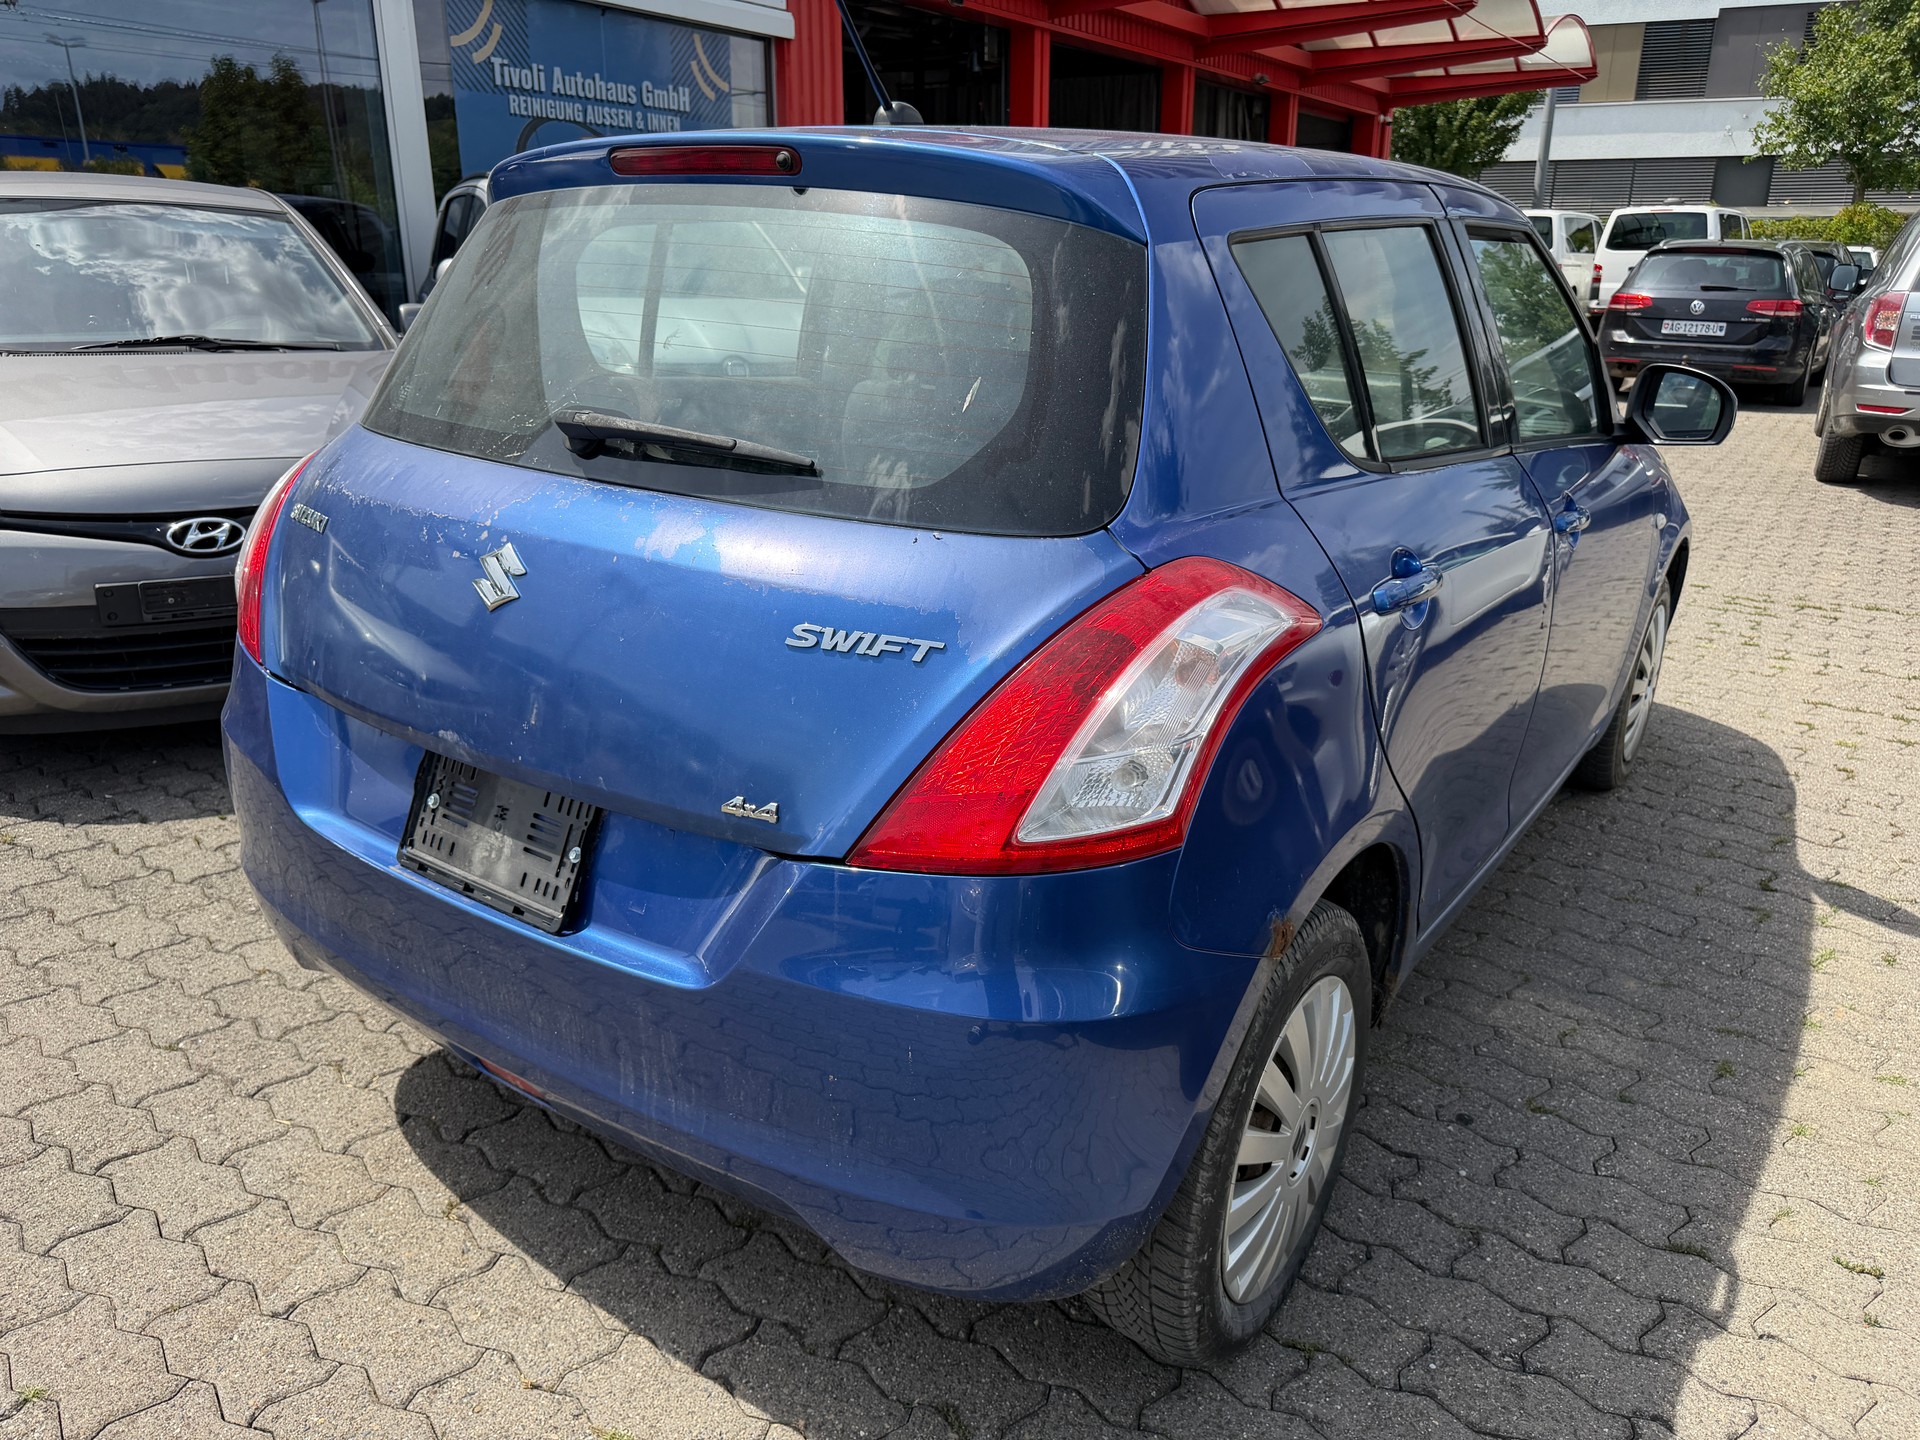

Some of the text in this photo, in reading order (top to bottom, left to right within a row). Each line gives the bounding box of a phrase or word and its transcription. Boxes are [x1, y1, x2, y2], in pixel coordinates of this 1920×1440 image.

[490, 57, 691, 112] Tivoli Autohaus GmbH
[508, 94, 584, 122] REINIGUNG
[586, 104, 633, 129] AUSSEN
[635, 111, 645, 131] &
[785, 622, 946, 663] SWIFT
